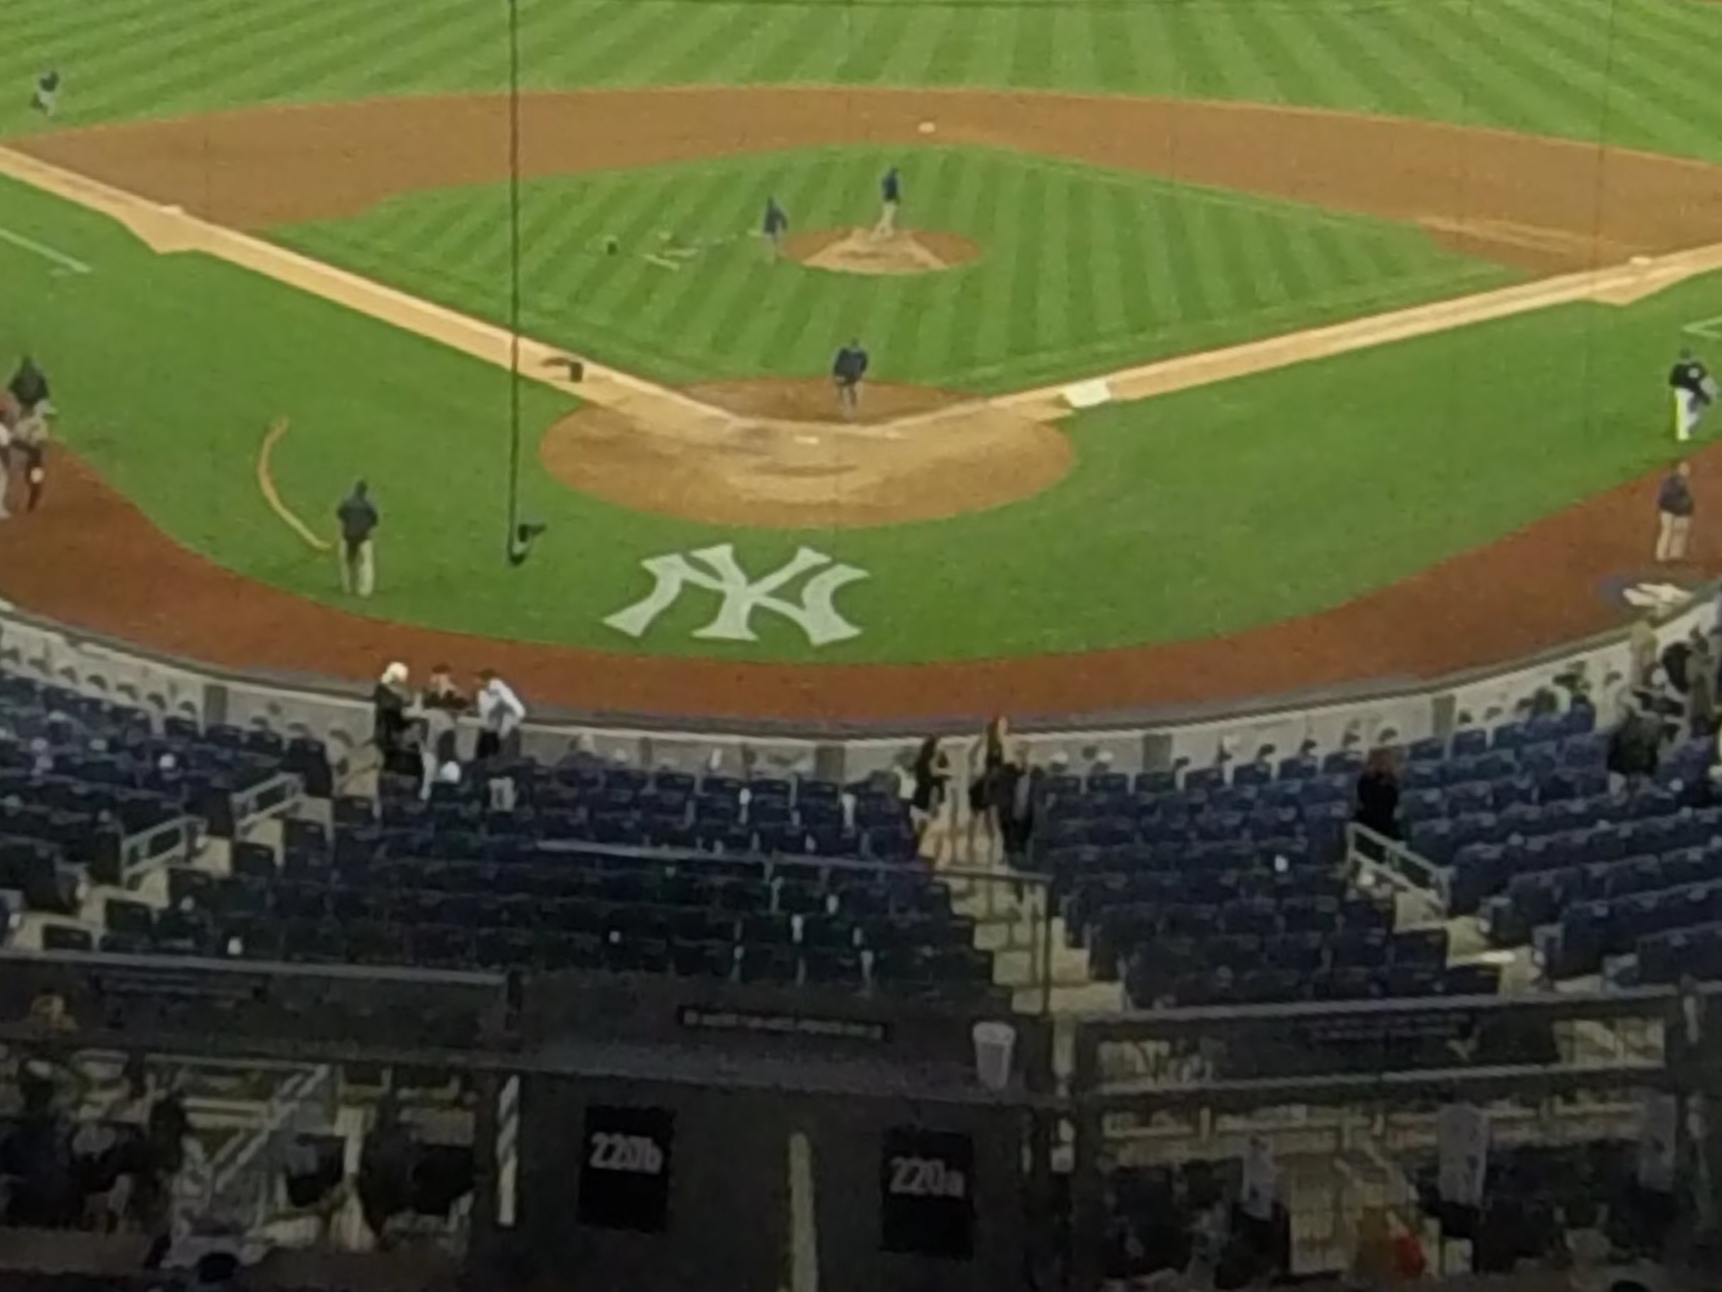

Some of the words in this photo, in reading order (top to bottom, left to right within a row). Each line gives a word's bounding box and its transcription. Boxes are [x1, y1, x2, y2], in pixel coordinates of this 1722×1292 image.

[602, 542, 871, 647] NY
[589, 1131, 663, 1175] 220b
[889, 1155, 966, 1198] 220a
